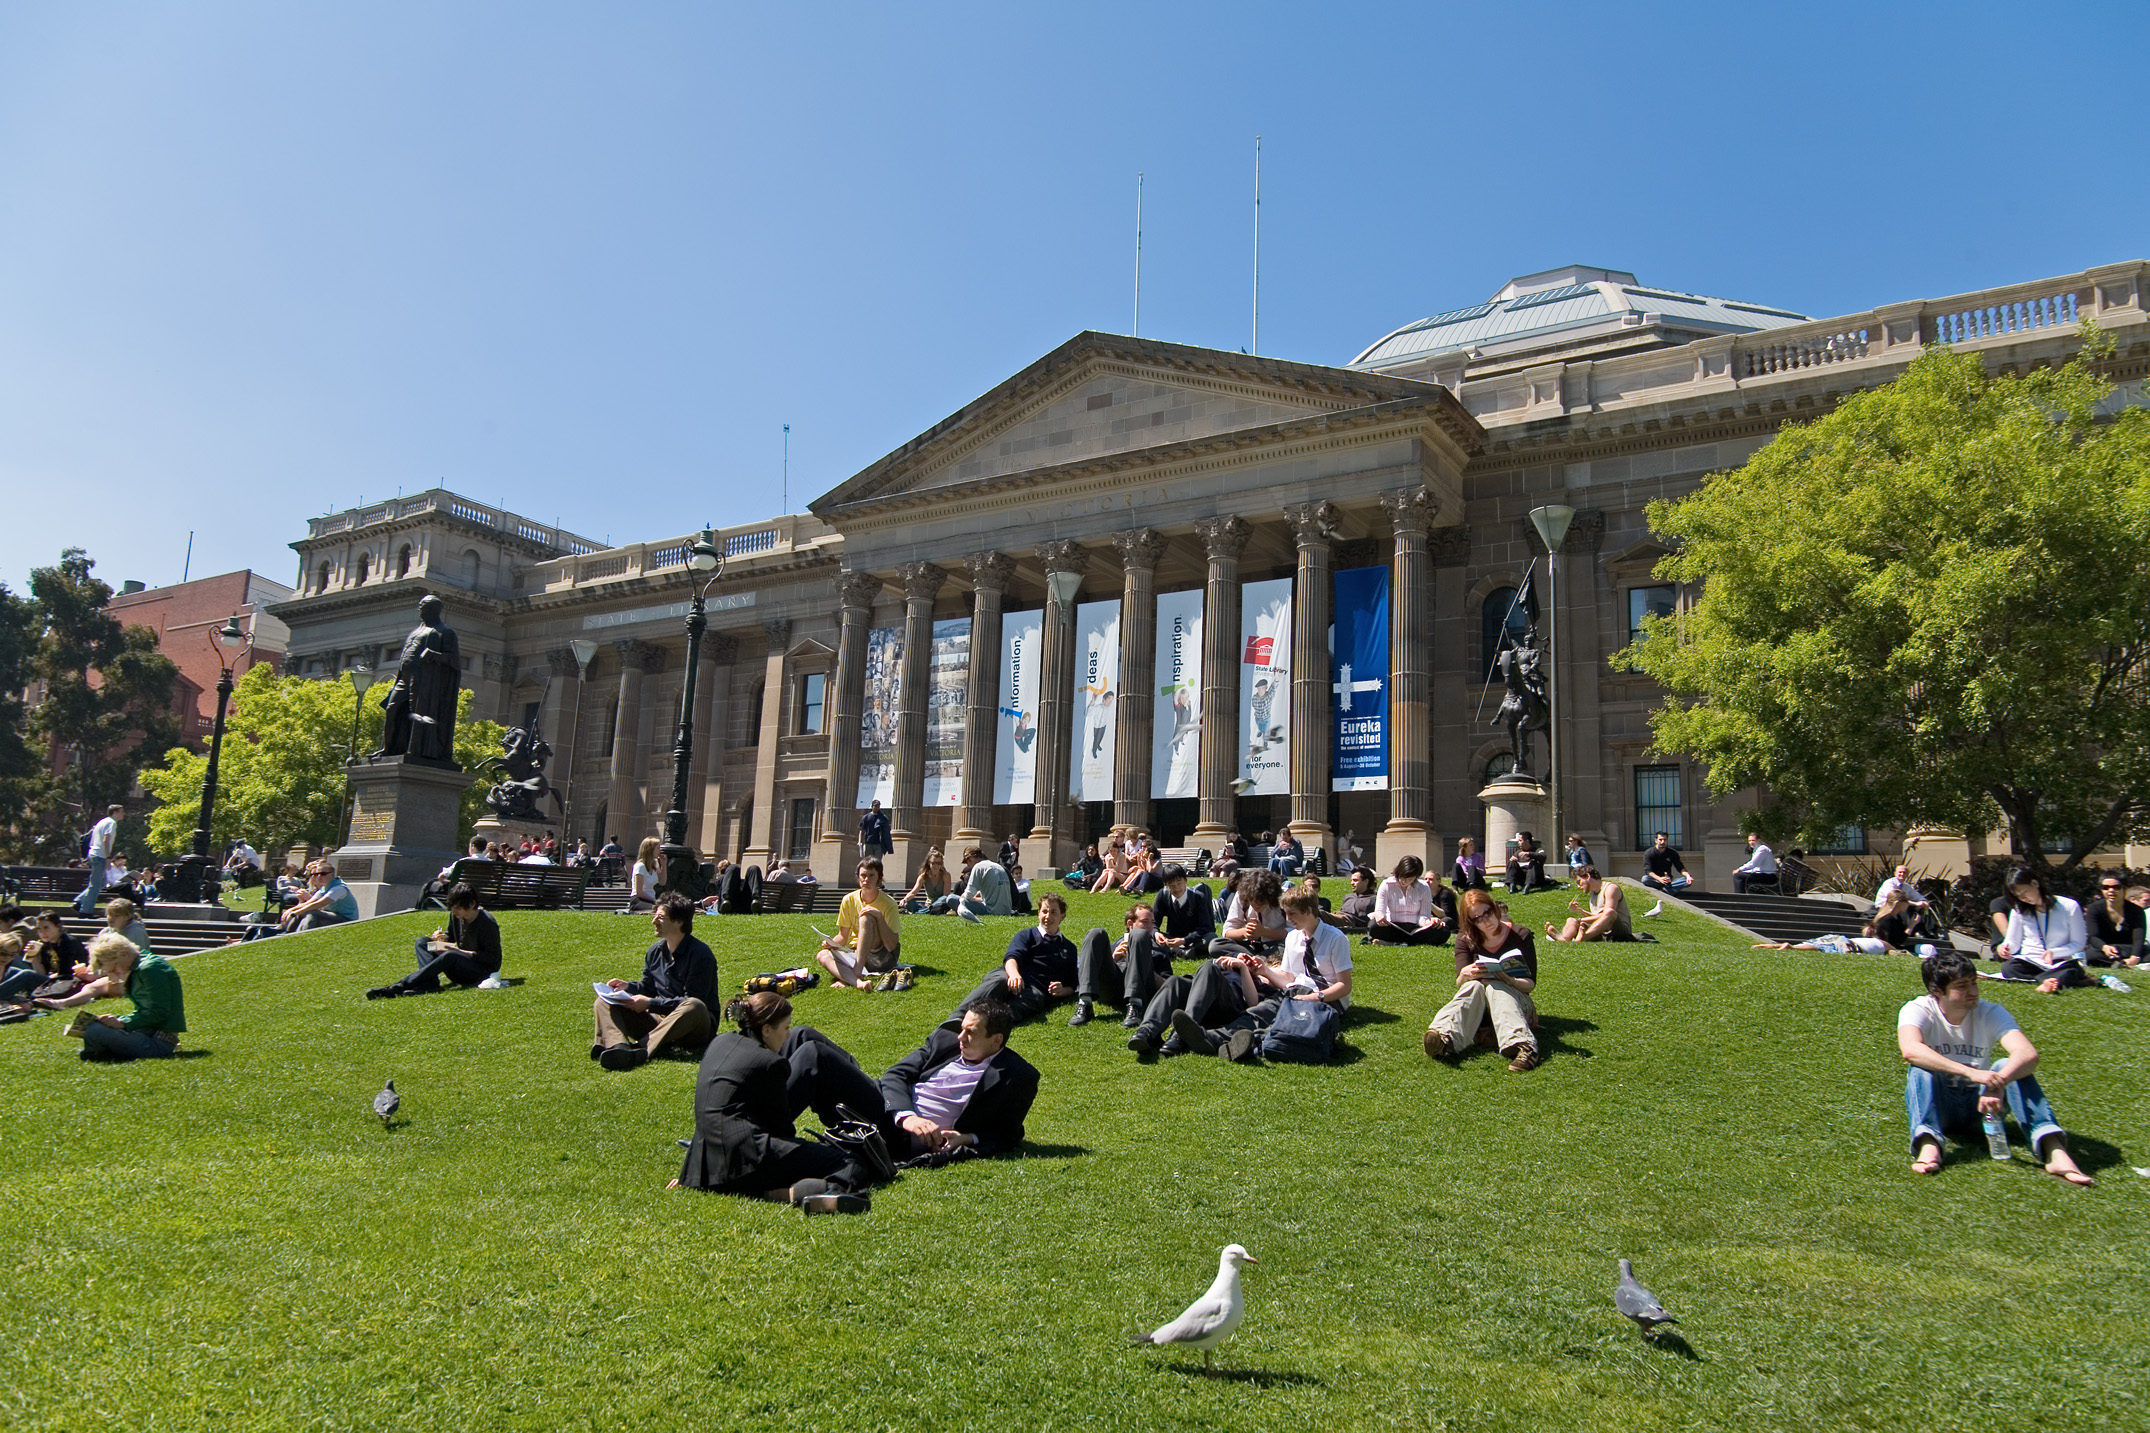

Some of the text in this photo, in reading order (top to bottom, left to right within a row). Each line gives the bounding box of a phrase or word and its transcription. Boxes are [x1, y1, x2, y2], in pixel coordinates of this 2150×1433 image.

[586, 611, 638, 628] STATE
[1269, 666, 1288, 675] Library
[1340, 719, 1381, 734] Eureka
[1340, 733, 1381, 746] revisited
[864, 753, 895, 761] VICTORIA
[929, 749, 961, 757] VICTORIA
[1340, 755, 1381, 764] Free exhibition
[1245, 761, 1284, 770] everyone.
